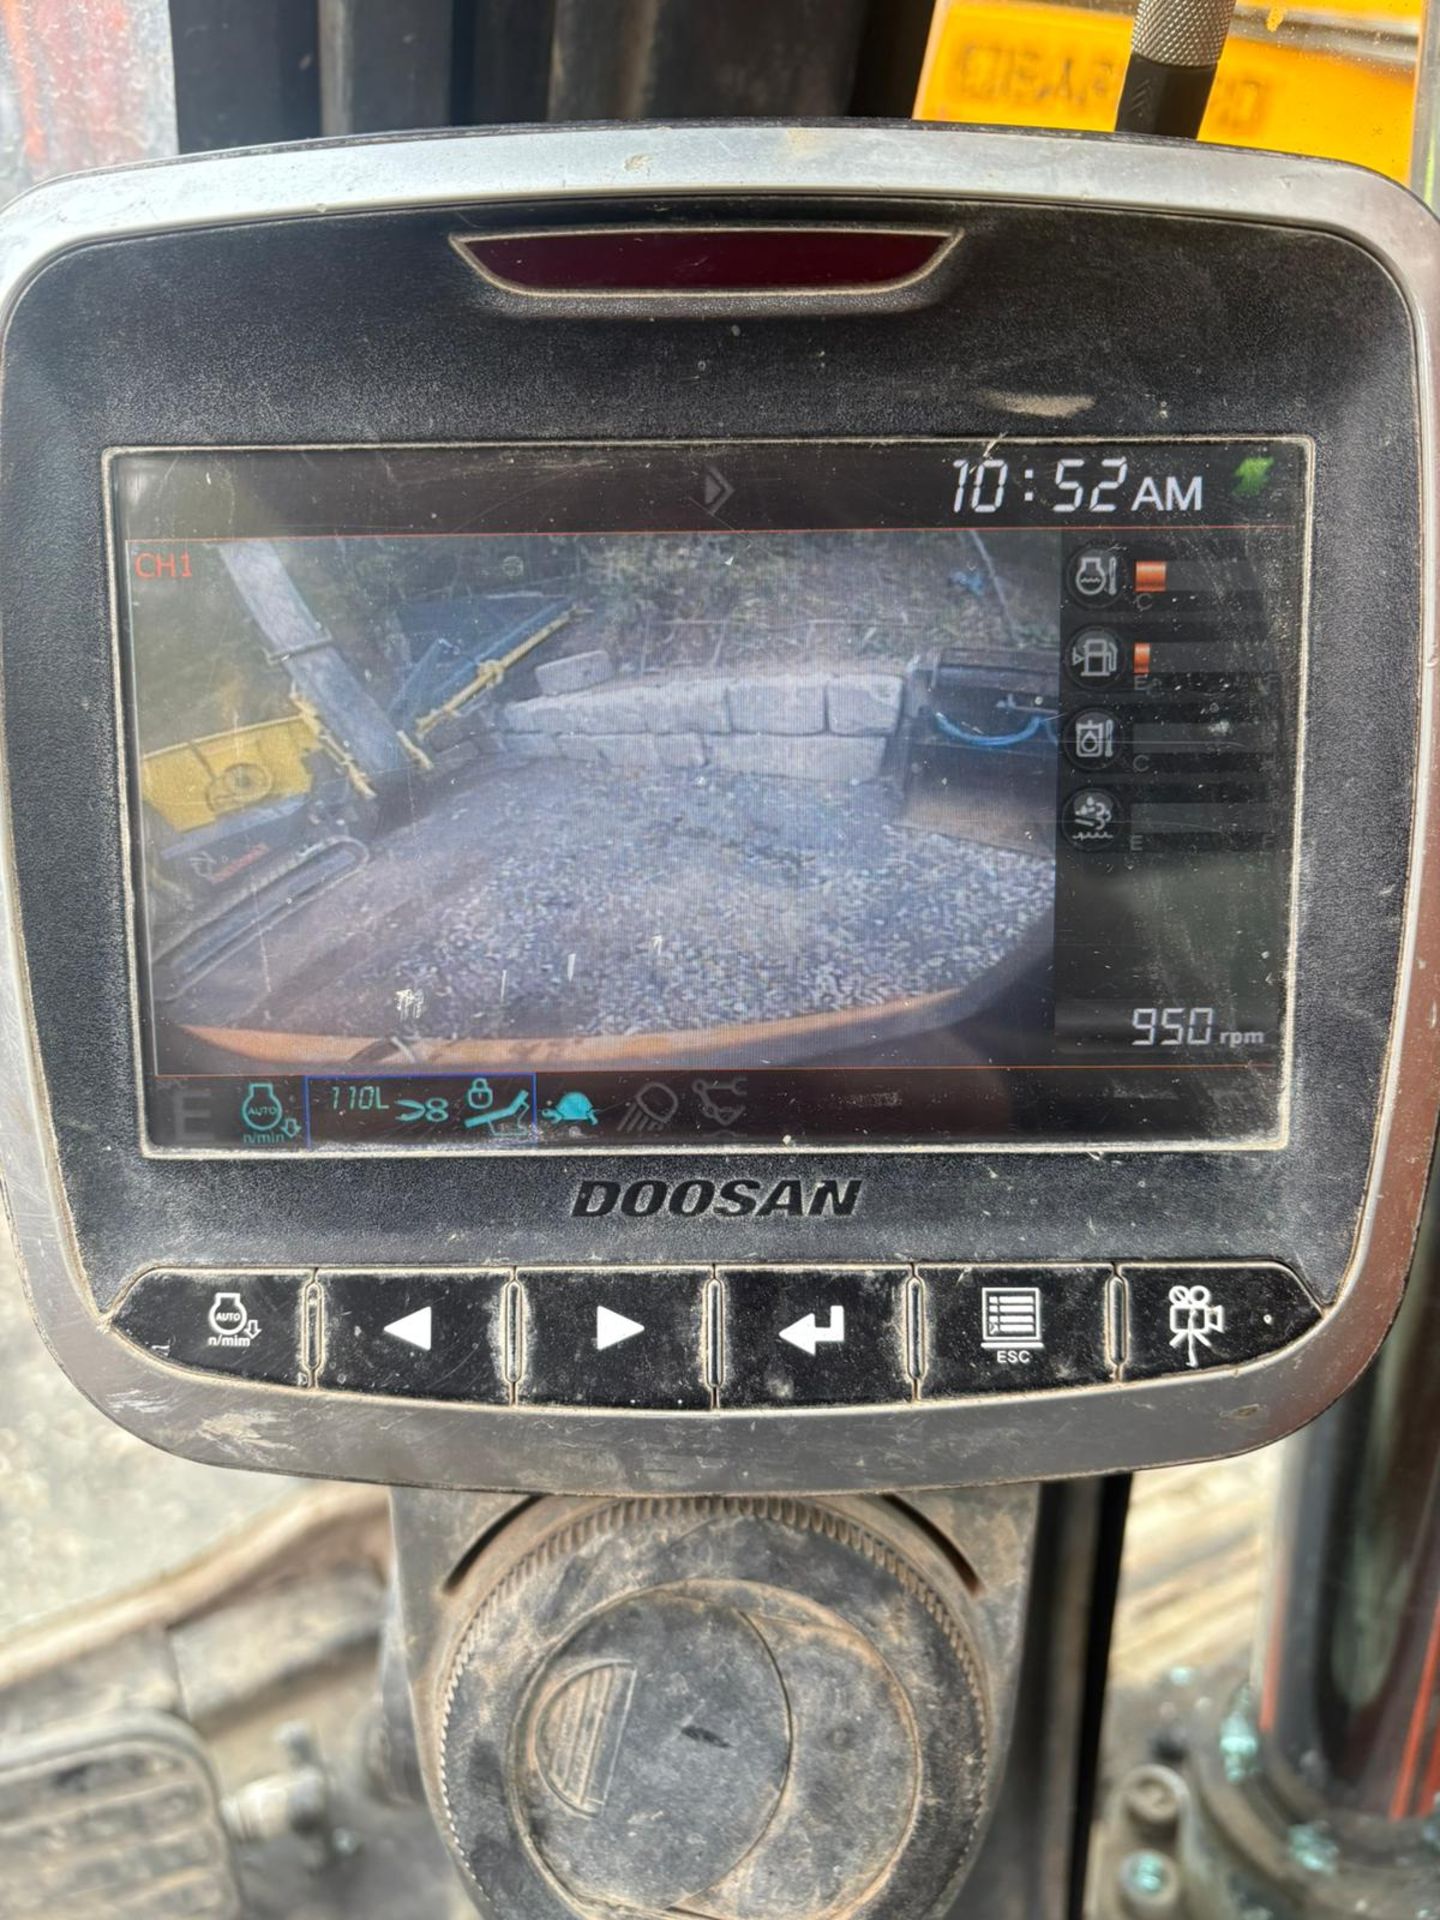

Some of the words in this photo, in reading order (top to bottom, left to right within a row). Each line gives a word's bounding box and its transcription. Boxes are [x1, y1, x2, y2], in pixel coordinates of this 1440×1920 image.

[1131, 476, 1202, 511] AM
[132, 552, 192, 579] CH1
[1132, 754, 1150, 772] C
[1129, 834, 1143, 851] E
[1131, 1007, 1214, 1045] 950
[1219, 1031, 1265, 1048] rpm
[247, 1106, 277, 1116] AUTO
[571, 1179, 862, 1217] DOOSAN
[216, 1312, 241, 1322] AUTO
[996, 1350, 1031, 1364] ESC
